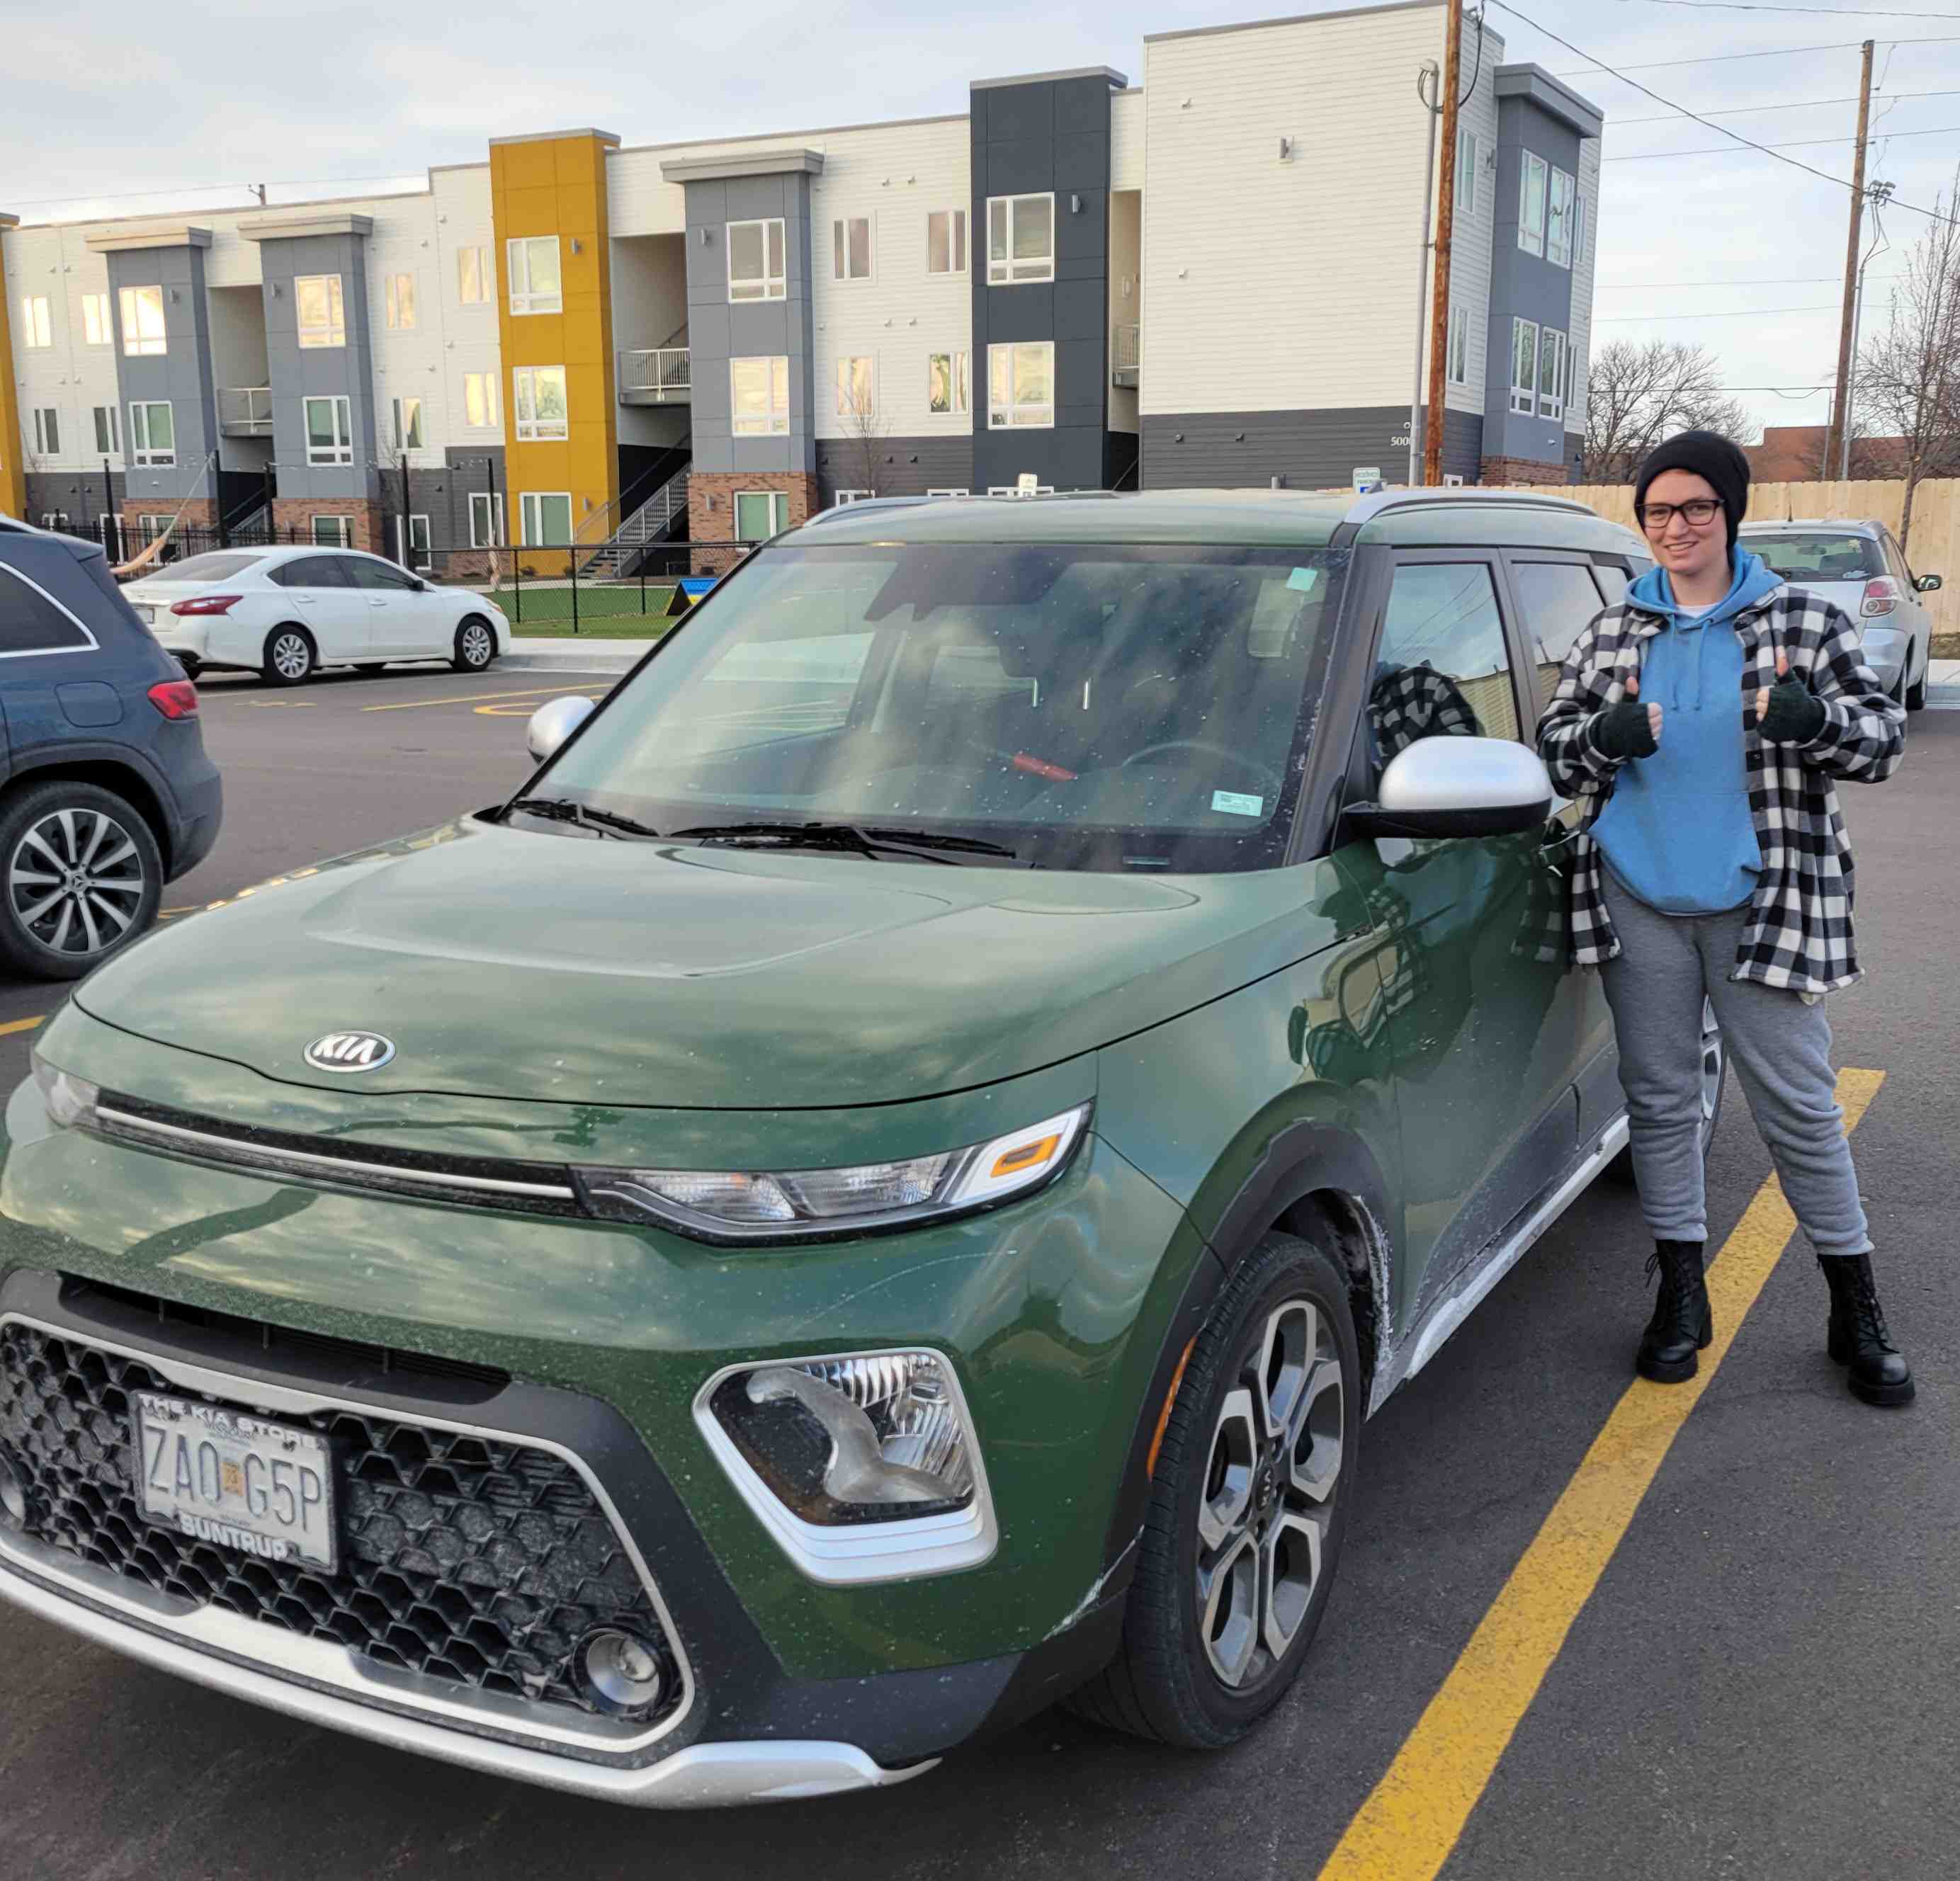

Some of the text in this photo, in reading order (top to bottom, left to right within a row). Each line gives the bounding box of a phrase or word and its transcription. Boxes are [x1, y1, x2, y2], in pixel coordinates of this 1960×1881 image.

[312, 1035, 378, 1063] KIA
[137, 1393, 186, 1416] THE
[191, 1404, 231, 1427] KIA
[244, 1452, 322, 1533] G5P
[180, 1511, 288, 1561] SUNTRUP
